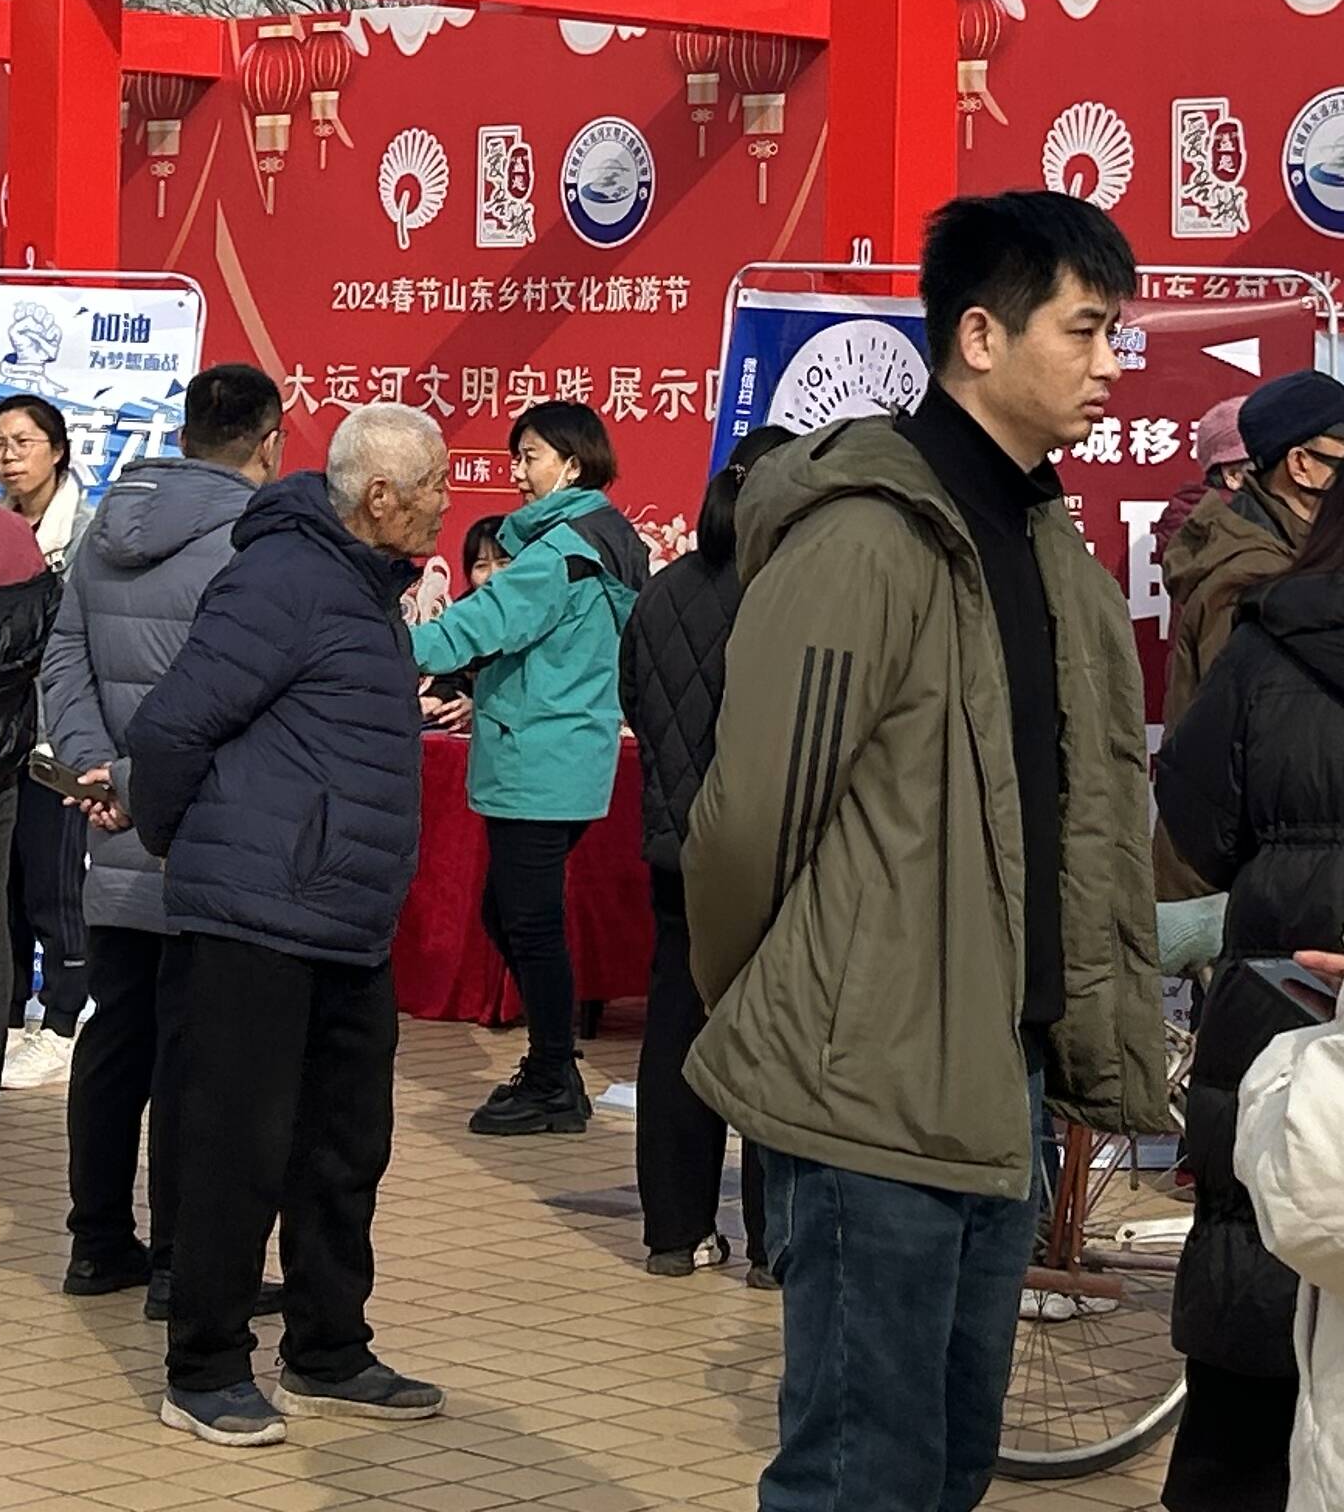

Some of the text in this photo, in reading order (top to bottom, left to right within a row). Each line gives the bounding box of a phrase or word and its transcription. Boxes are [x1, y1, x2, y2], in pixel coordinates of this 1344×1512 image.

[852, 237, 872, 265] 10
[332, 276, 691, 314] 2024春节山东乡村文化旅游节
[91, 311, 152, 345] 加油
